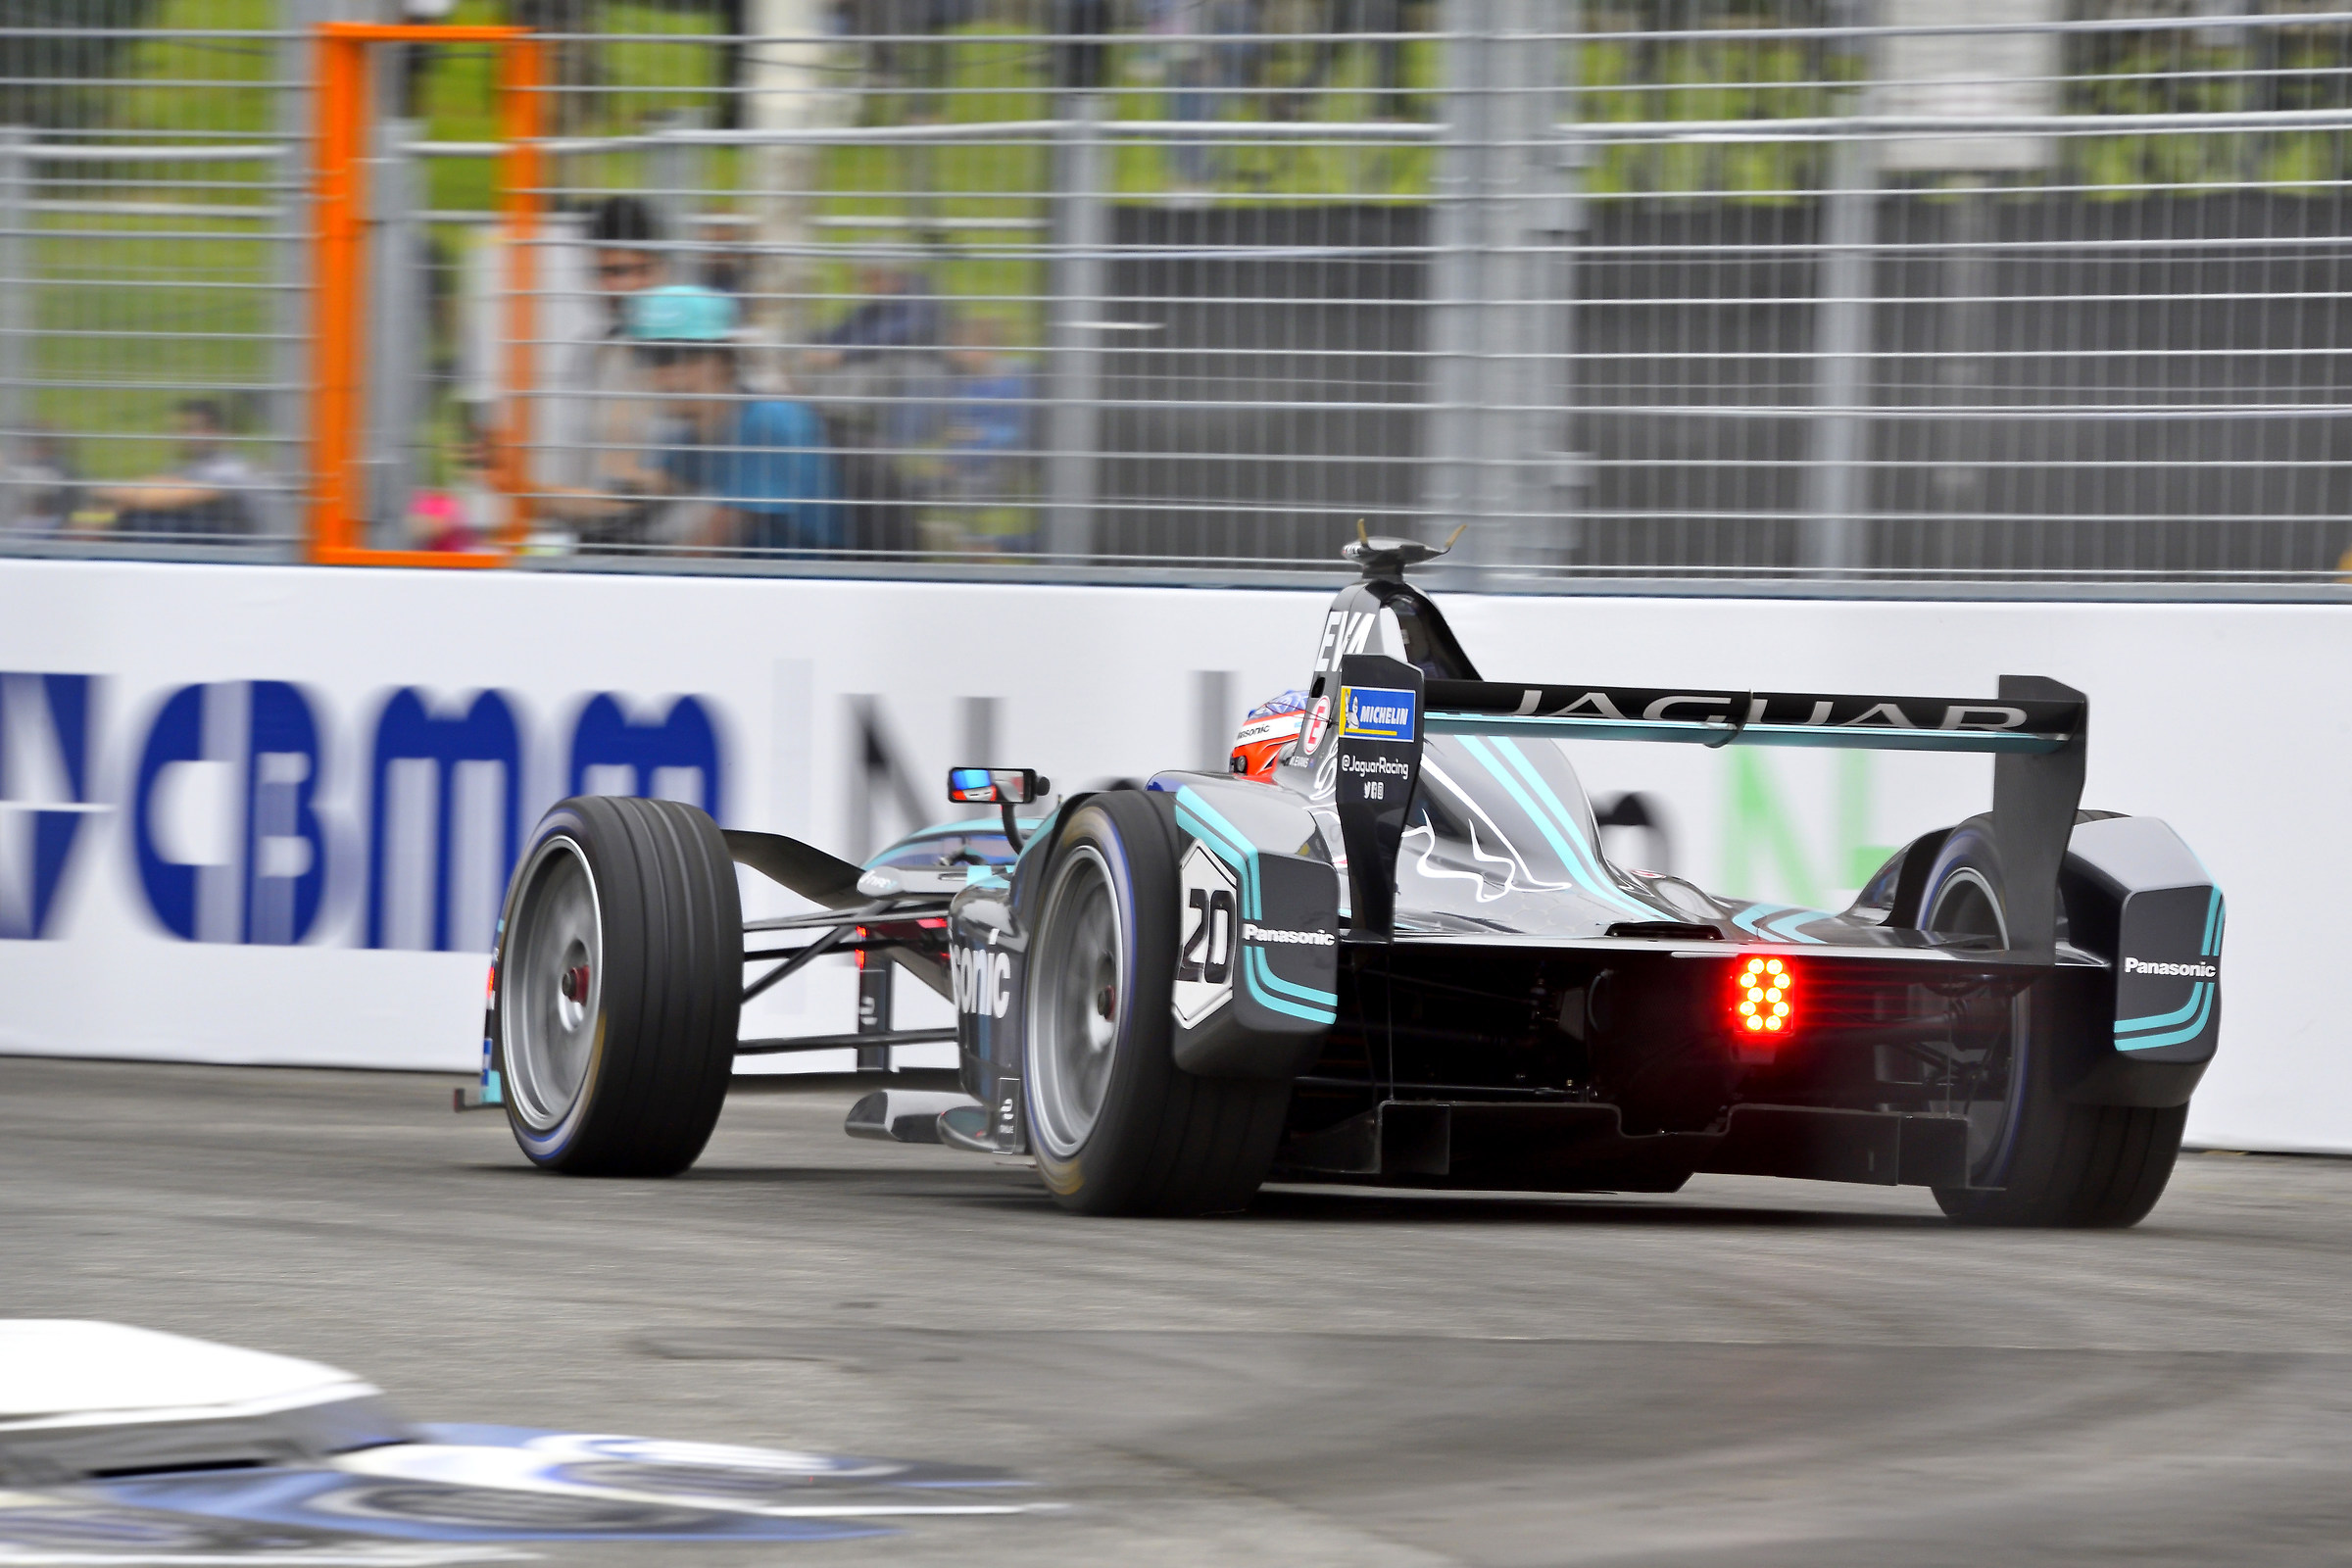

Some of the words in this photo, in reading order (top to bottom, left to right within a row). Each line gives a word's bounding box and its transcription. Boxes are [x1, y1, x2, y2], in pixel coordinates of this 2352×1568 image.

[1359, 706, 1409, 725] MICHELIN
[1507, 689, 2031, 733] JAGUAR
[1342, 755, 1409, 780] @JaguarRacing
[1176, 888, 1236, 983] 20
[1243, 923, 1336, 946] Panasonic
[2125, 956, 2216, 977] Panasonic
